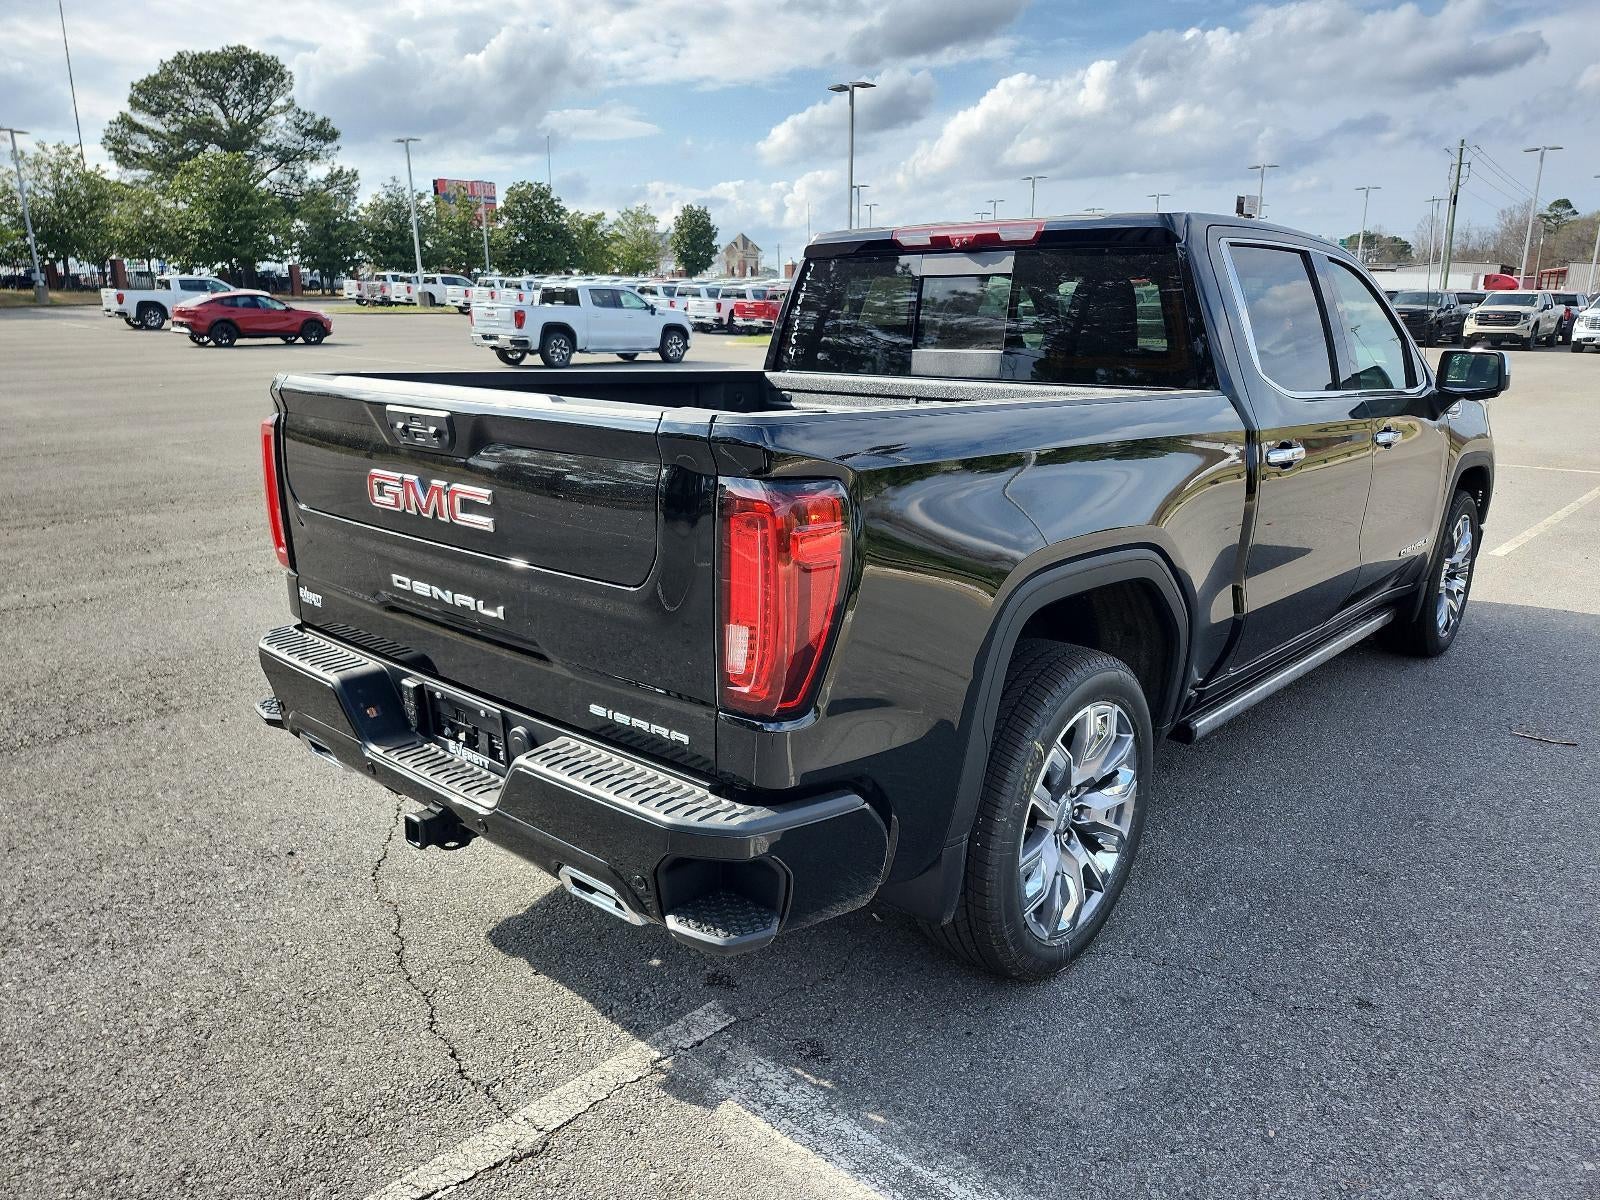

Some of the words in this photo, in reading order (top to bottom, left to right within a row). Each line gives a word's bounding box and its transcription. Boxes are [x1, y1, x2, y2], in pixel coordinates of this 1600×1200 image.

[367, 468, 496, 533] GMC
[391, 573, 505, 621] DENALI
[589, 703, 690, 745] SIERRA
[448, 740, 490, 770] EVERETT
